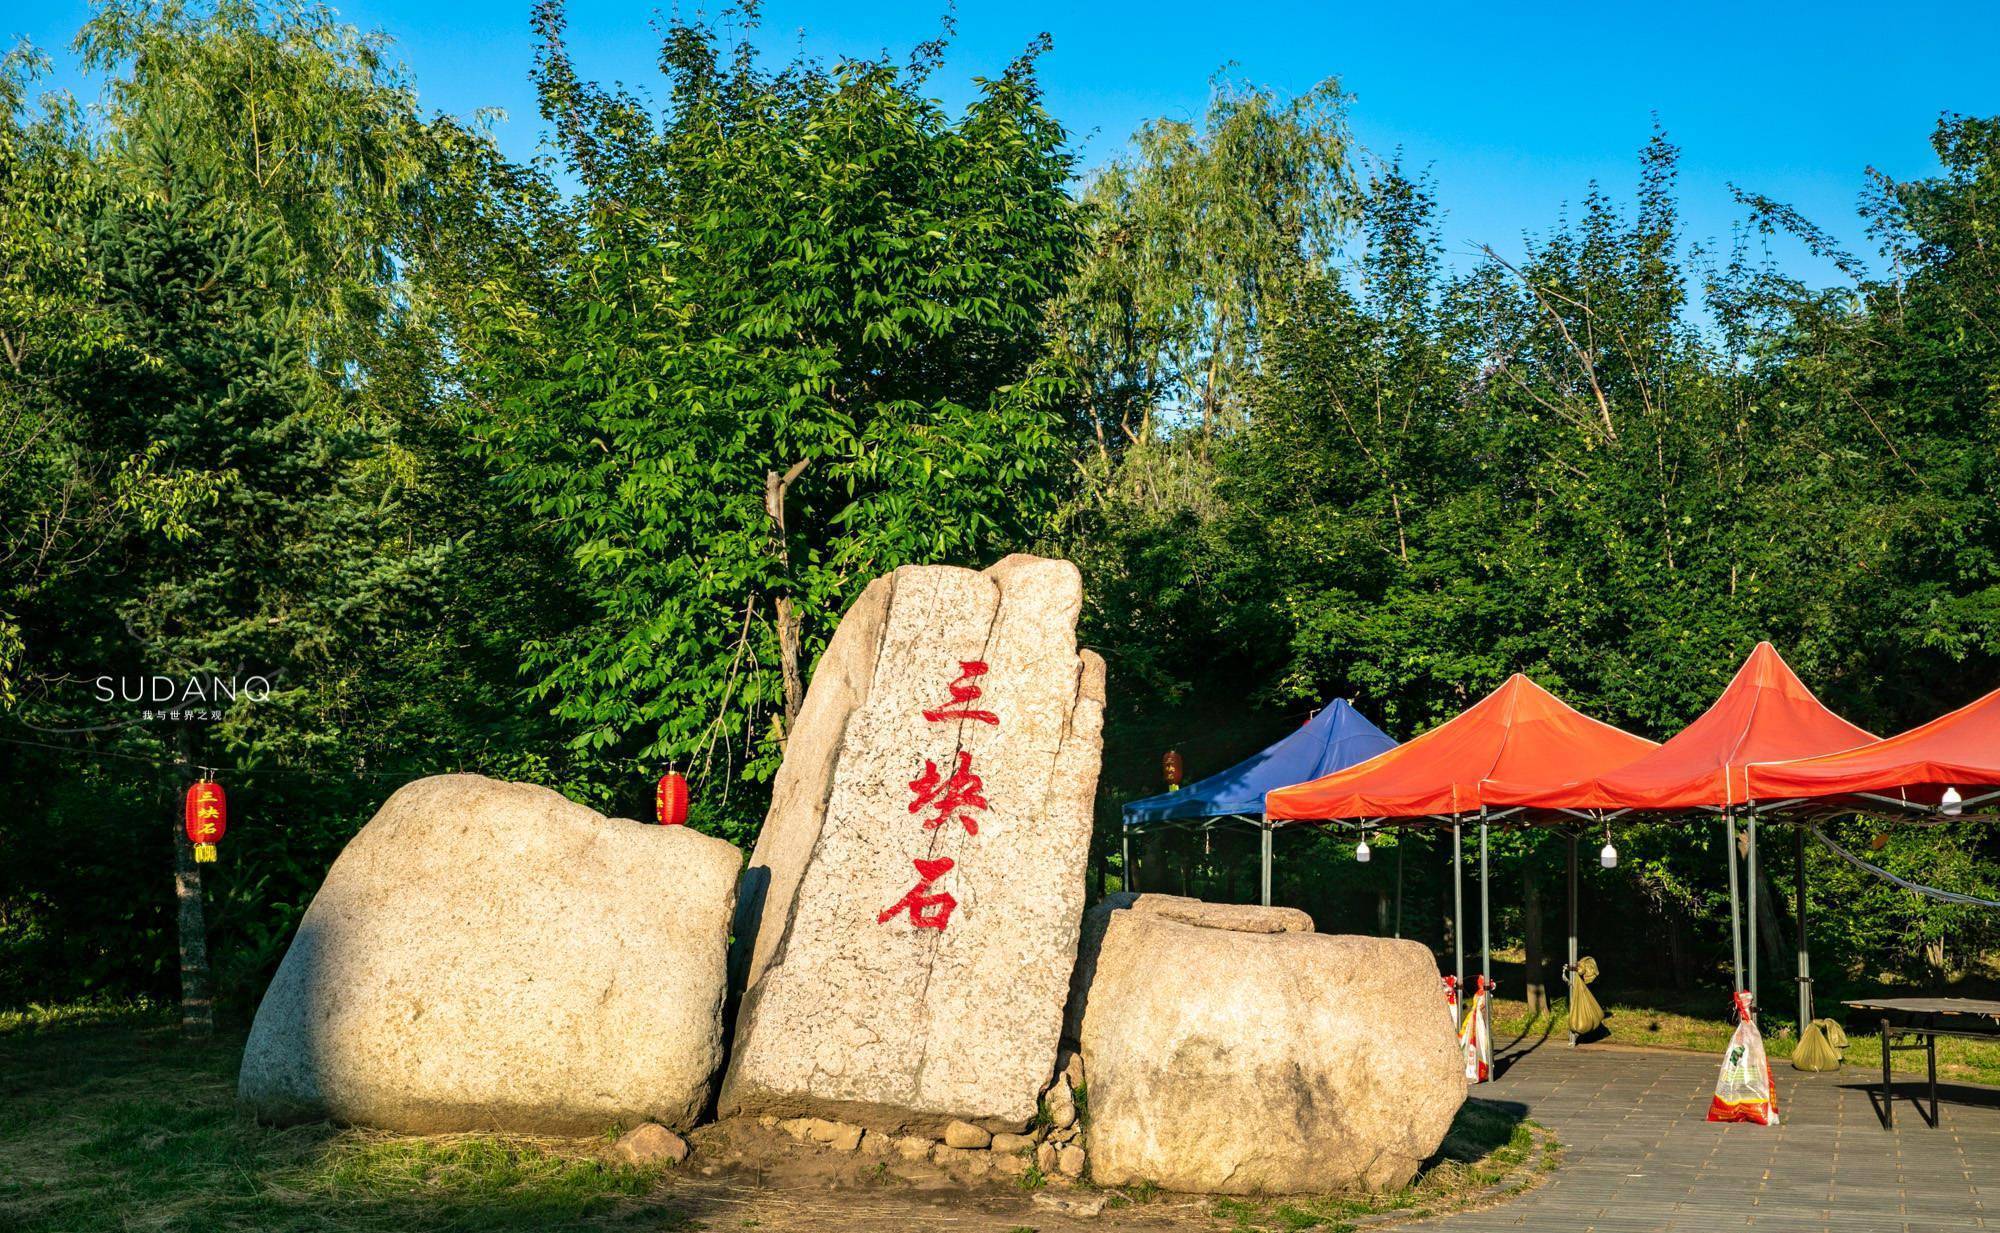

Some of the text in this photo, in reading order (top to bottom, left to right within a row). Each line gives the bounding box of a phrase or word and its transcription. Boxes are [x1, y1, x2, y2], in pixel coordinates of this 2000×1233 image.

[197, 791, 219, 834] 三块石
[877, 660, 1000, 931] 三块石
